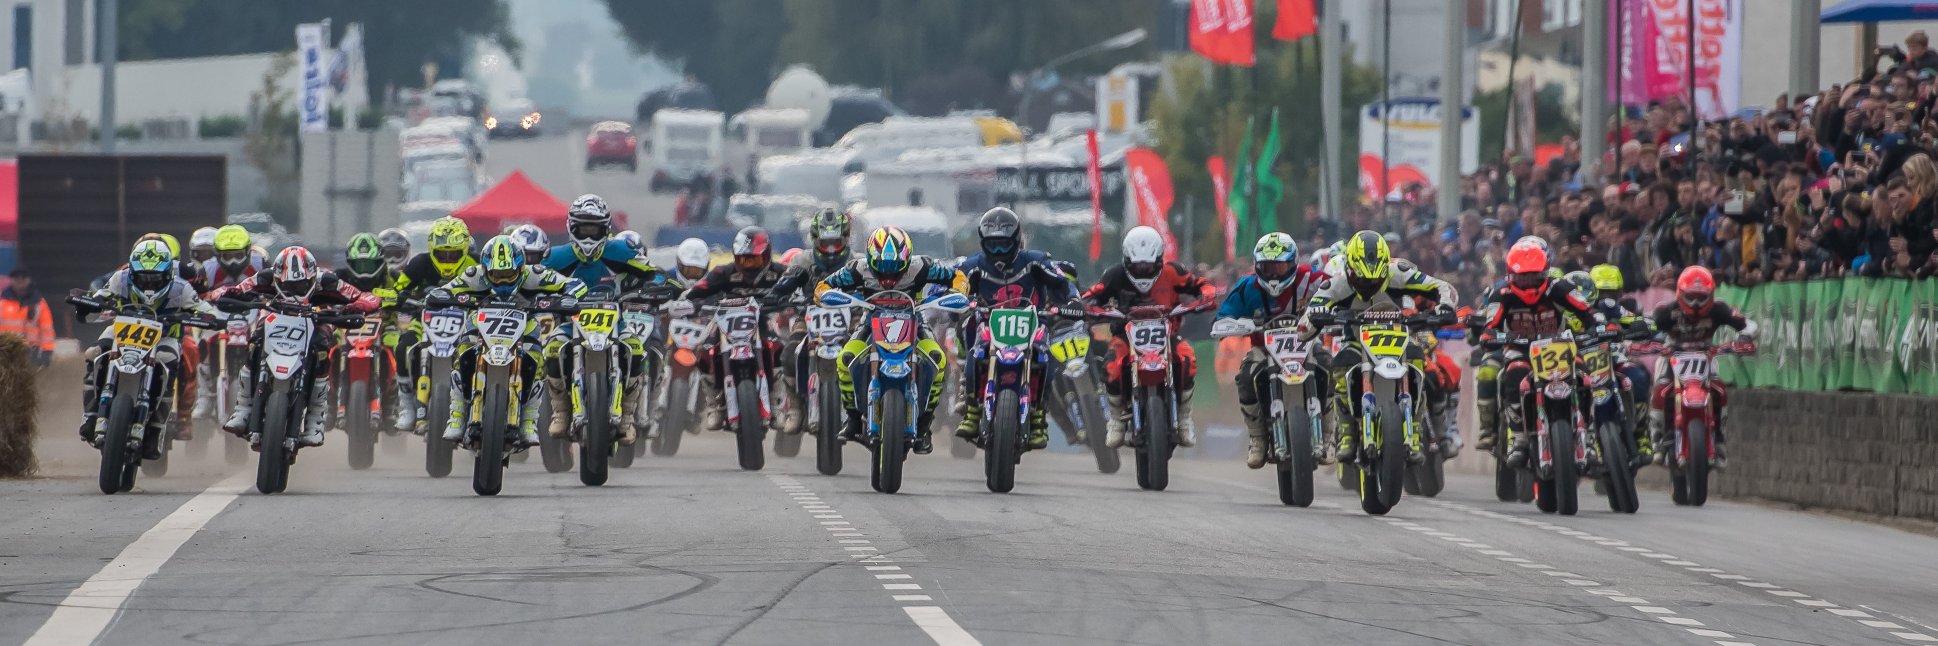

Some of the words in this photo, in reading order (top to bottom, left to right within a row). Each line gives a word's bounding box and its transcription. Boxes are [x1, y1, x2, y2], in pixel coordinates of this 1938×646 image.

[429, 316, 461, 333] 96
[484, 318, 520, 336] 72
[580, 313, 614, 328] 941
[727, 315, 756, 333] 16
[812, 312, 845, 329] 113
[998, 315, 1030, 338] 115
[117, 324, 158, 346] 449
[269, 325, 305, 341] 20
[885, 319, 905, 343] 1
[1135, 328, 1167, 346] 92
[1275, 336, 1307, 353] 742
[1535, 348, 1573, 373] 134
[1680, 360, 1707, 374] 711
